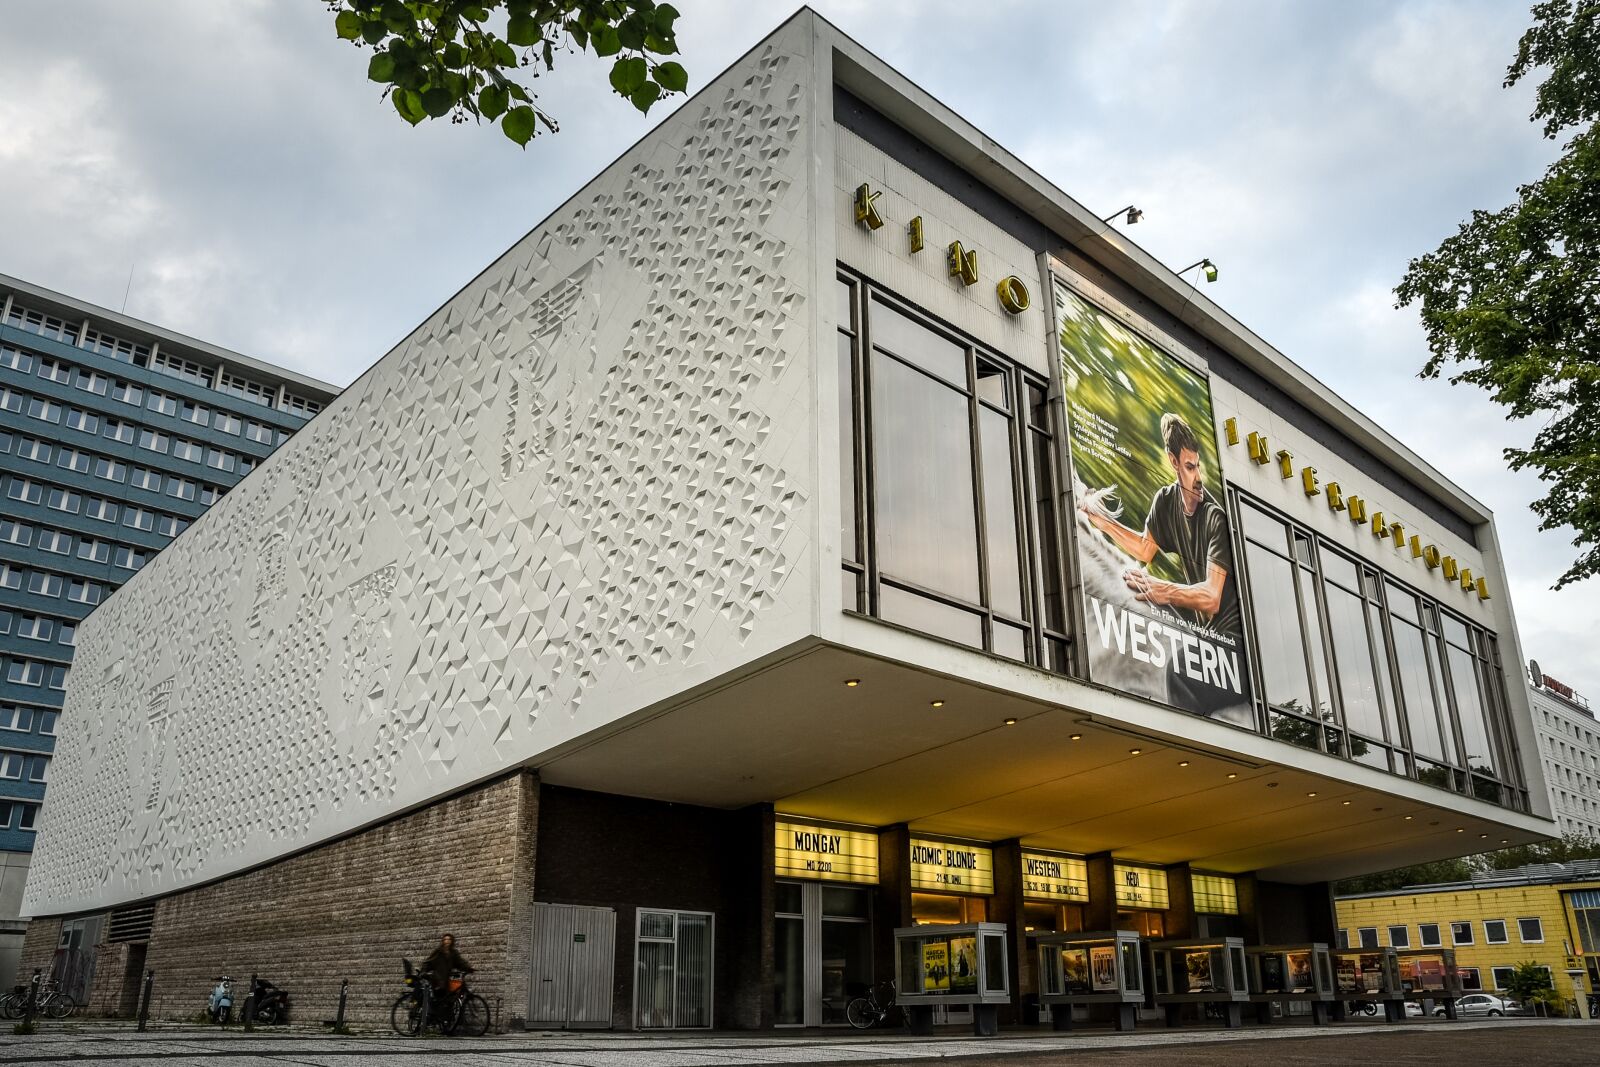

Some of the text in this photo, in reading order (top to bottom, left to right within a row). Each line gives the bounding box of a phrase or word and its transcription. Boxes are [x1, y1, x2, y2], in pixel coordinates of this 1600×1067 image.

[854, 183, 1030, 314] KINO
[1224, 416, 1491, 600] INTERNATIONAL
[1091, 597, 1242, 695] WESTERN
[1151, 605, 1236, 647] Ein Film von Valeska Grisebach
[795, 831, 841, 855] MONGAY
[912, 846, 977, 870] ATOMIC BLONDE
[1027, 859, 1061, 878] WESTERN
